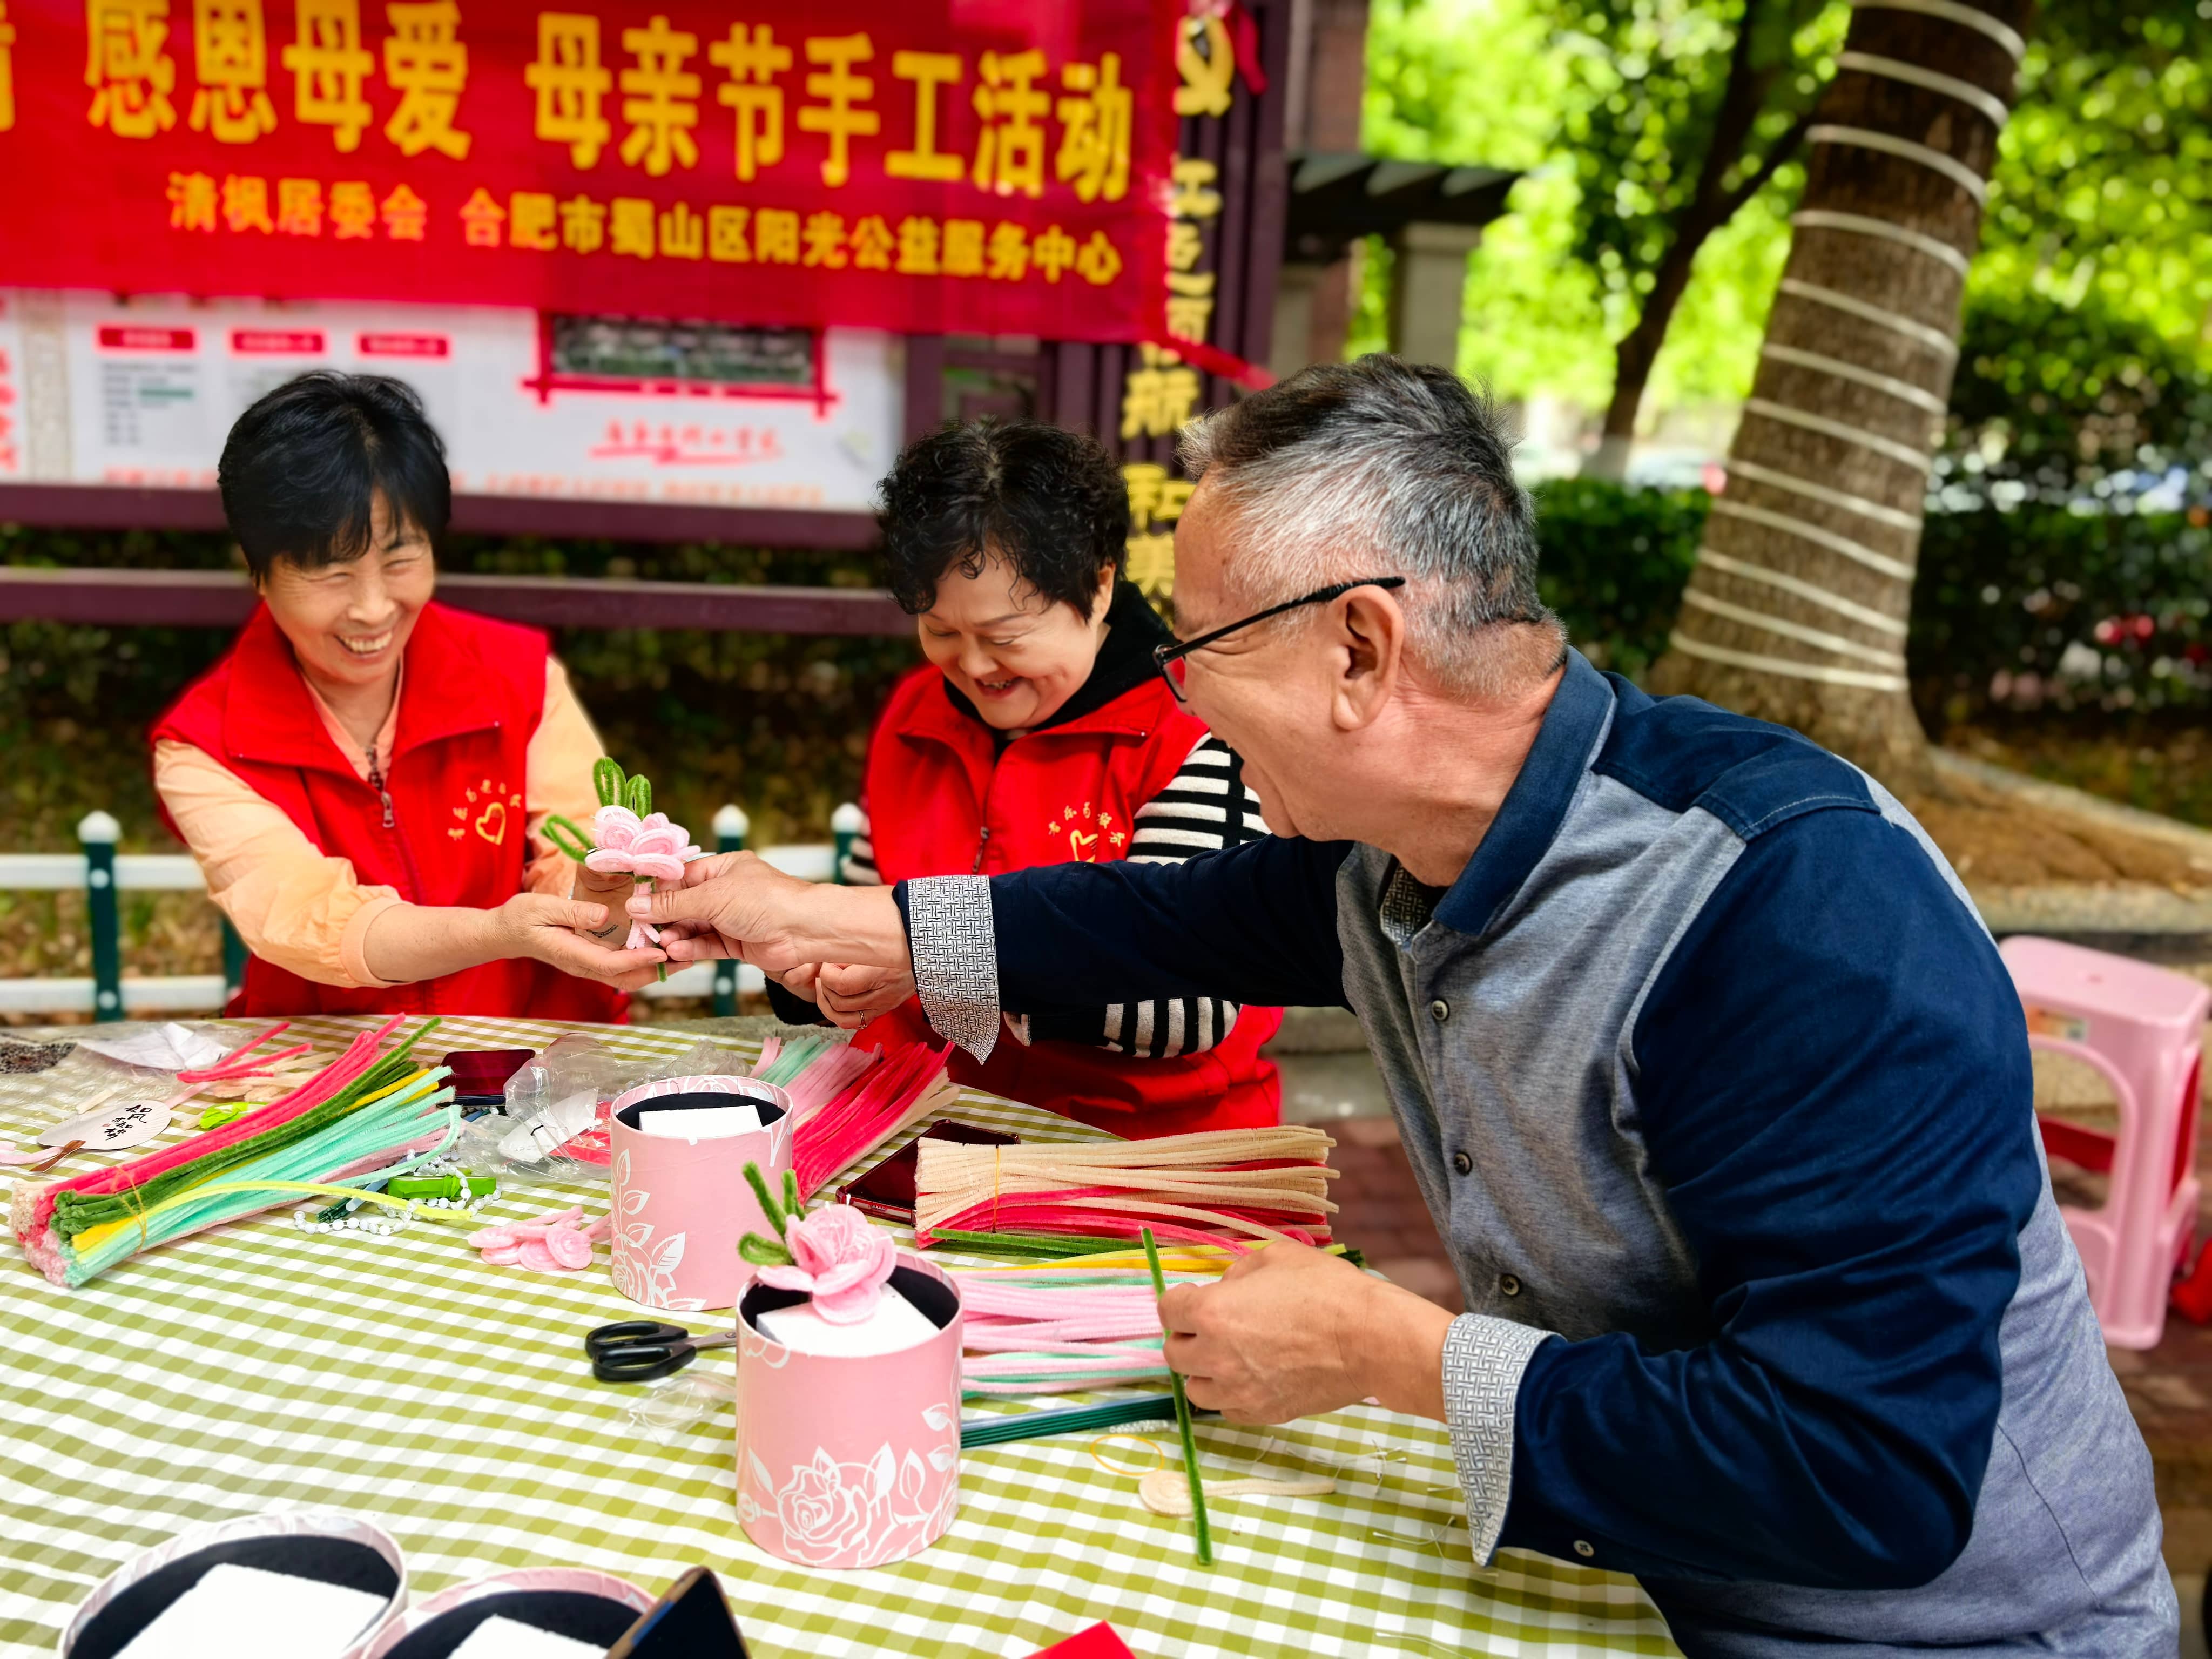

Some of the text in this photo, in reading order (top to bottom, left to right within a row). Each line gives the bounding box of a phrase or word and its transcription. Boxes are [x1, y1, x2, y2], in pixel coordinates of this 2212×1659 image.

[84, 0, 471, 160] 感恩母爱
[525, 14, 1134, 203] 母亲节手工活动
[166, 171, 1123, 286] 清枫居委会 合肥市蜀山区阳光公益服务中心
